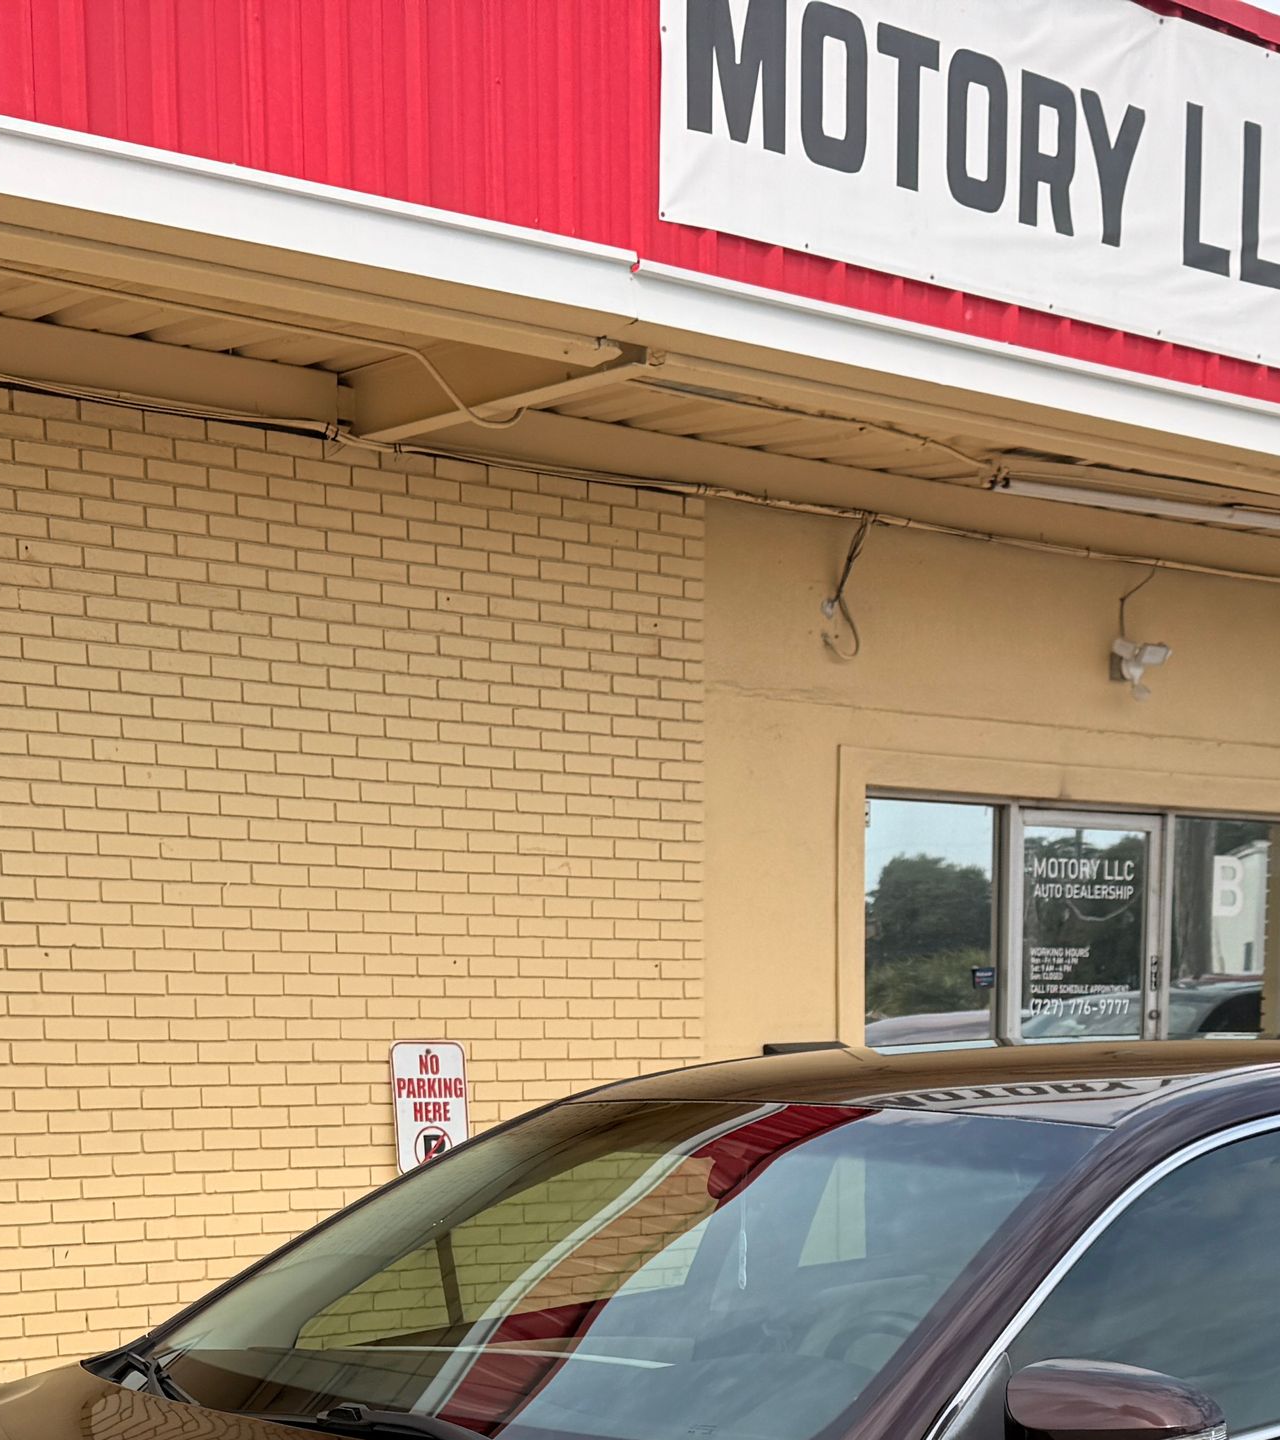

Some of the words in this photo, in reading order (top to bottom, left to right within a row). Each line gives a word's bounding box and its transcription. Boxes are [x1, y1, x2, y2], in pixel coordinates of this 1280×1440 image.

[686, 0, 1146, 248] MOTORY
[1033, 857, 1100, 880] MOTORY
[1104, 859, 1134, 880] LLC
[1033, 883, 1062, 898] AUTO
[1065, 884, 1134, 900] DEALERSHIP
[1213, 855, 1243, 916] B
[1030, 947, 1064, 957] WORKING
[1065, 947, 1089, 957] HOURS
[1030, 984, 1045, 994] CALL
[1046, 984, 1058, 994] FOR
[1059, 984, 1088, 994] SCHEDULE
[1030, 998, 1064, 1017] (727)
[1069, 999, 1130, 1016] 776-9777
[419, 1054, 440, 1075] NO
[397, 1077, 463, 1099] PARKING
[413, 1101, 451, 1122] HERE
